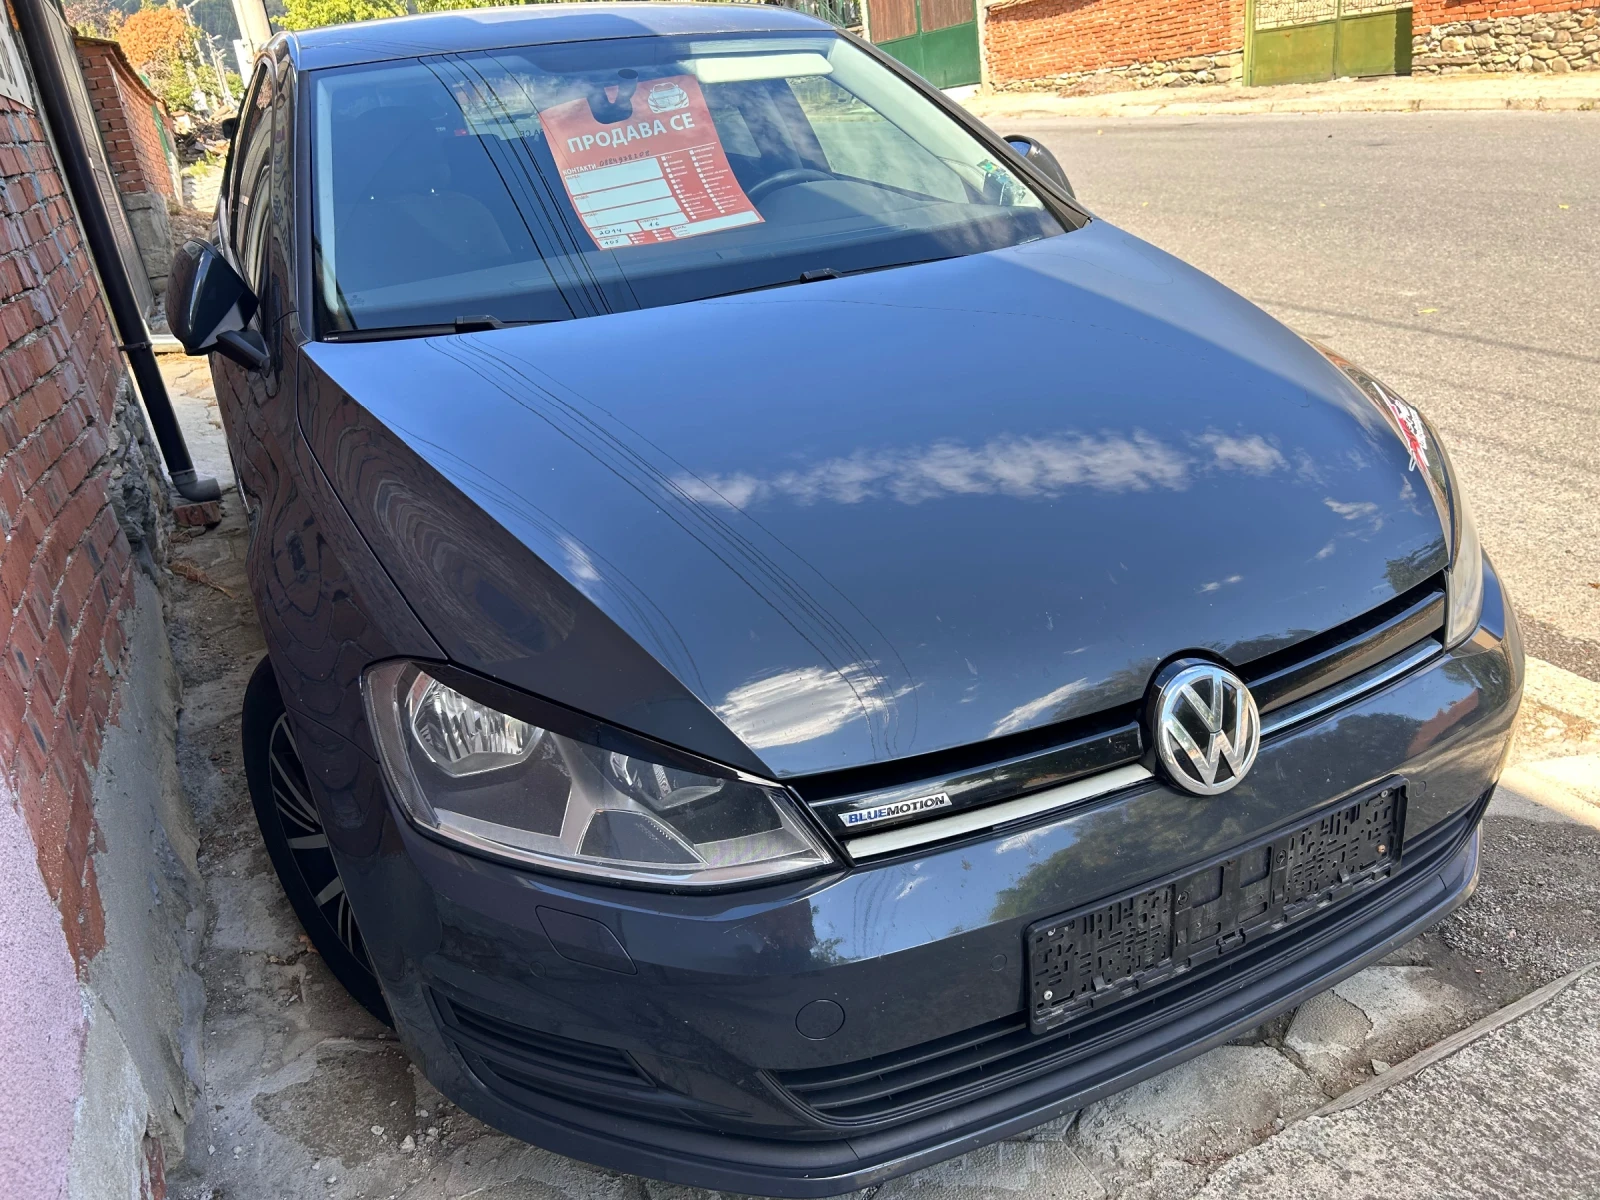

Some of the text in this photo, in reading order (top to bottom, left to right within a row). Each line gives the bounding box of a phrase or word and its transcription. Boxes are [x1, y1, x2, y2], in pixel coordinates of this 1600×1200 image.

[566, 112, 696, 153] ПРОДАВА СЕ
[562, 163, 597, 176] КОНТАКТИ
[848, 795, 945, 824] BLUEMOTION
